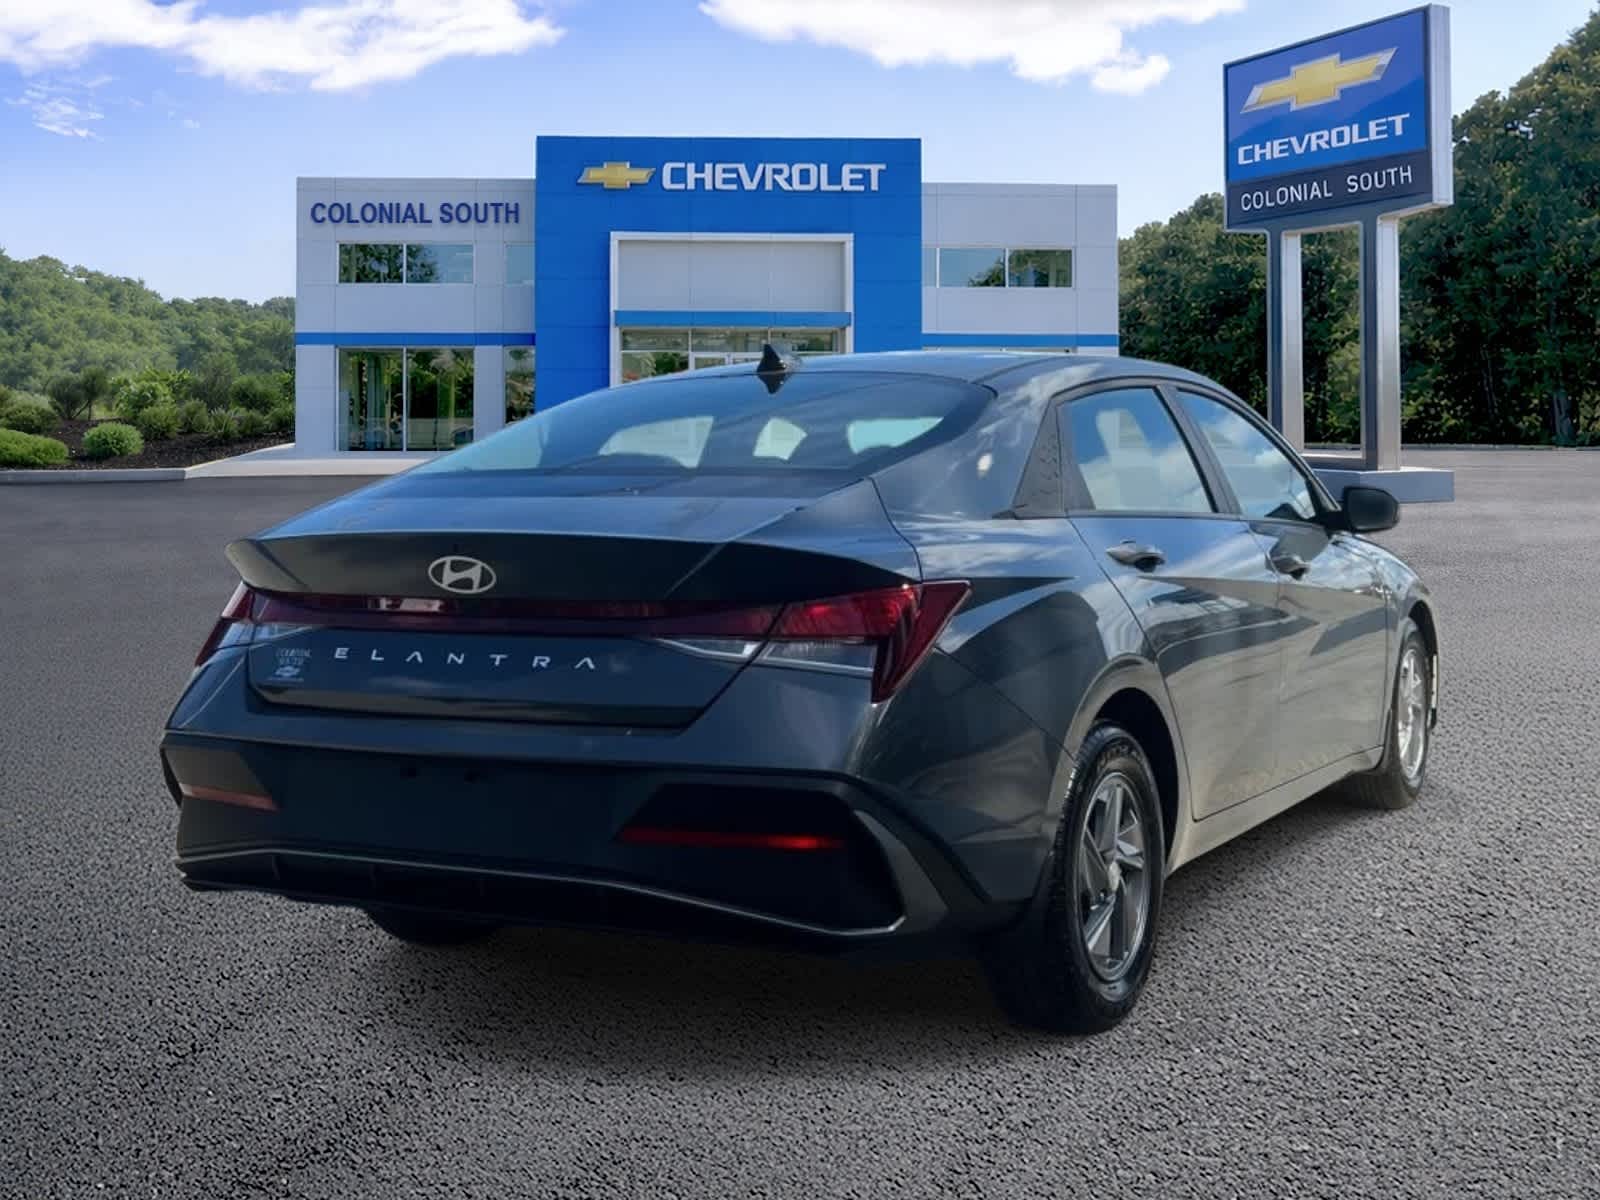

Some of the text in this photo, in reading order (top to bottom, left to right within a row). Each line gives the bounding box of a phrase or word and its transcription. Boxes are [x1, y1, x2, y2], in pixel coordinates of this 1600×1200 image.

[1237, 112, 1410, 165] CHEVROLET
[661, 162, 887, 192] CHEVROLET
[1240, 165, 1413, 211] COLONIAL SOUTH
[310, 202, 520, 225] COLONIAL SOUTH
[333, 646, 596, 671] ELANTRA
